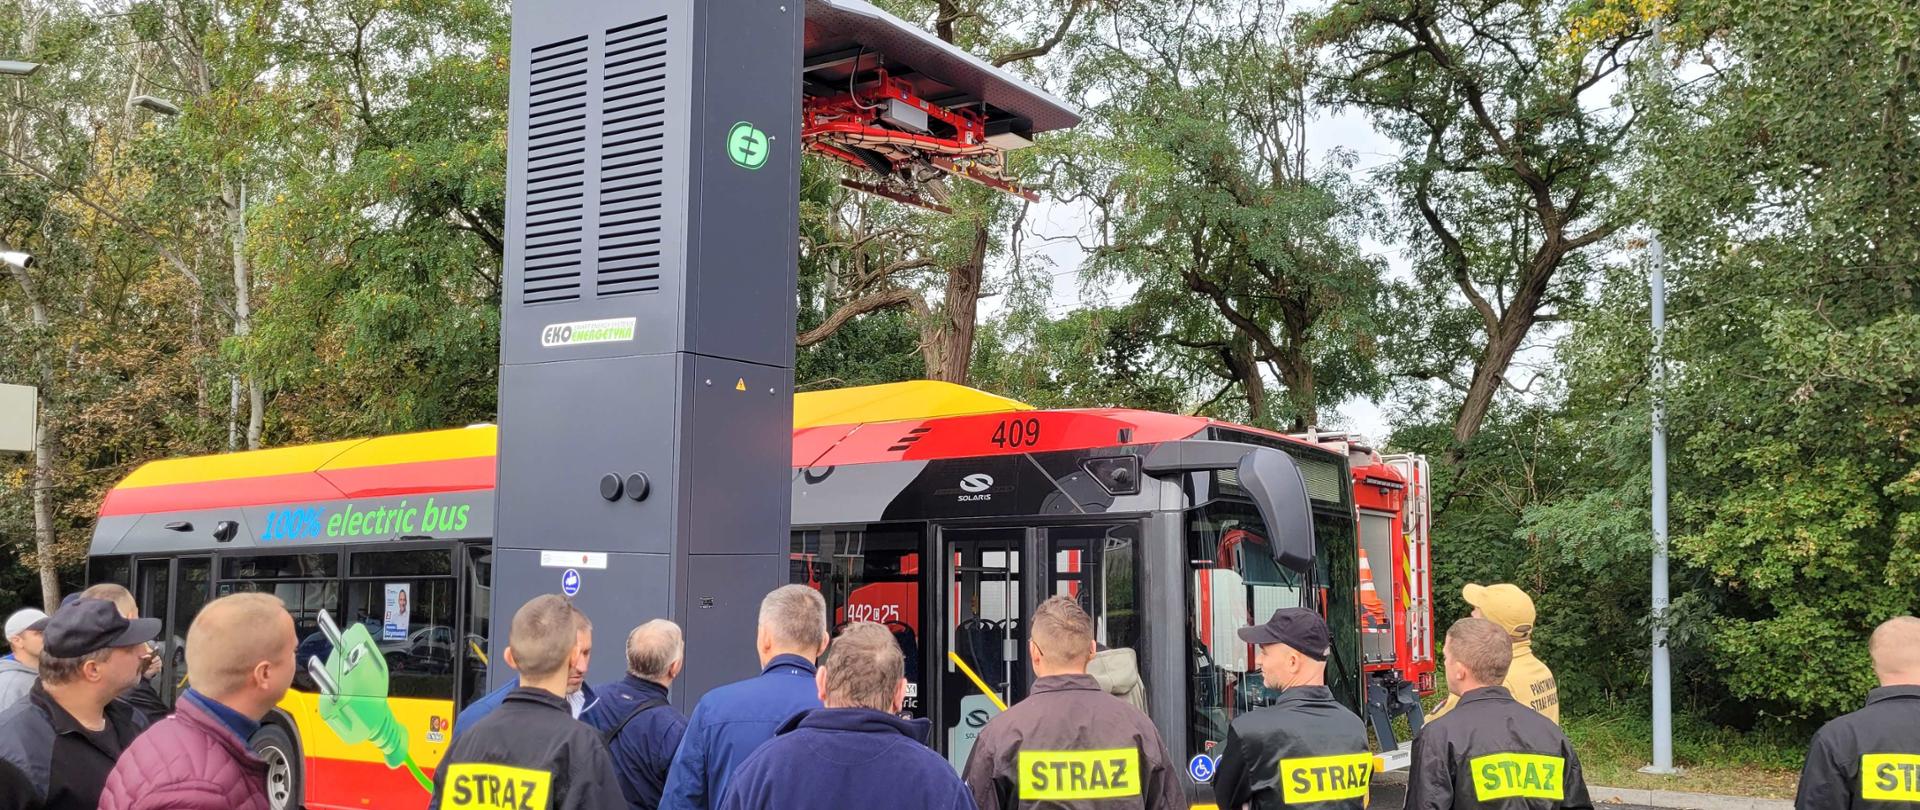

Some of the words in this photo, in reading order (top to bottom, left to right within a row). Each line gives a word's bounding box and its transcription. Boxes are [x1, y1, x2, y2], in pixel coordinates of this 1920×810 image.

[544, 326, 572, 344] EKO
[991, 418, 1040, 449] 409
[957, 493, 992, 502] SOLARIS
[260, 506, 326, 541] 100%
[326, 499, 418, 537] electric
[421, 497, 471, 533] bus
